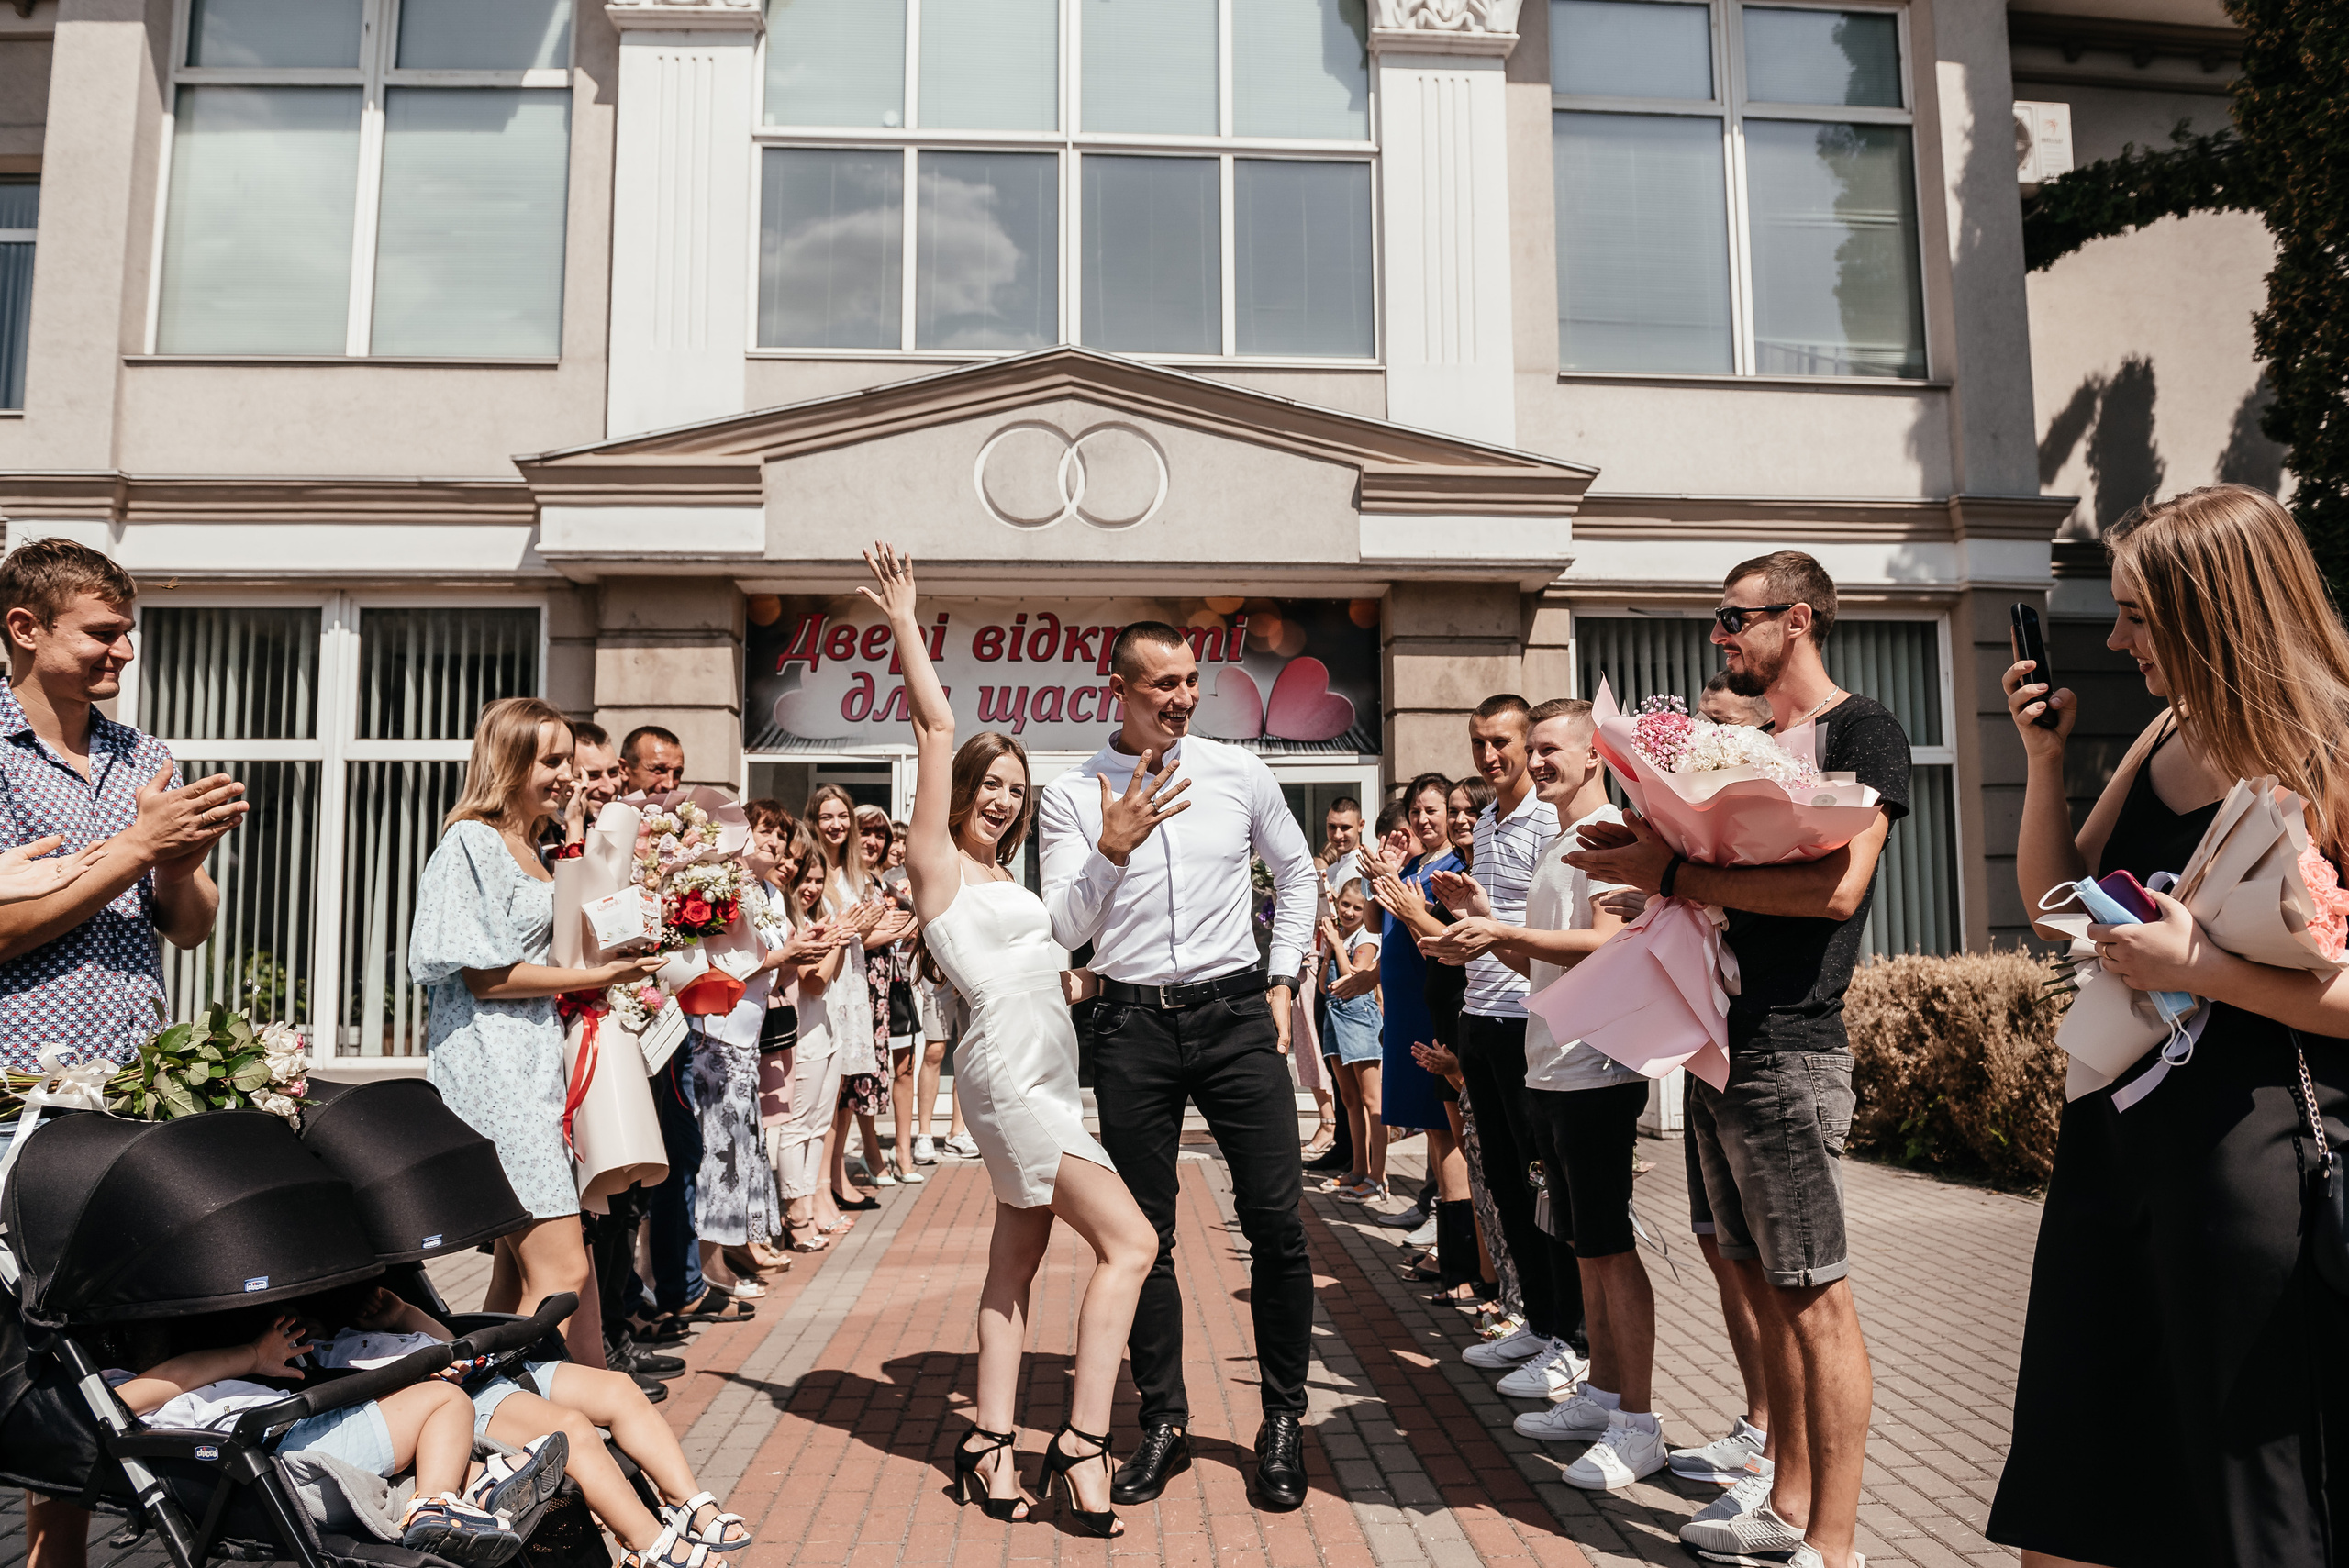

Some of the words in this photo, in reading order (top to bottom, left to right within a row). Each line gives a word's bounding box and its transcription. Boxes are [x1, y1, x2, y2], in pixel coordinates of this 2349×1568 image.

[972, 612, 1247, 676] відкрті
[841, 671, 952, 722] дл
[196, 1448, 217, 1458] chicco
